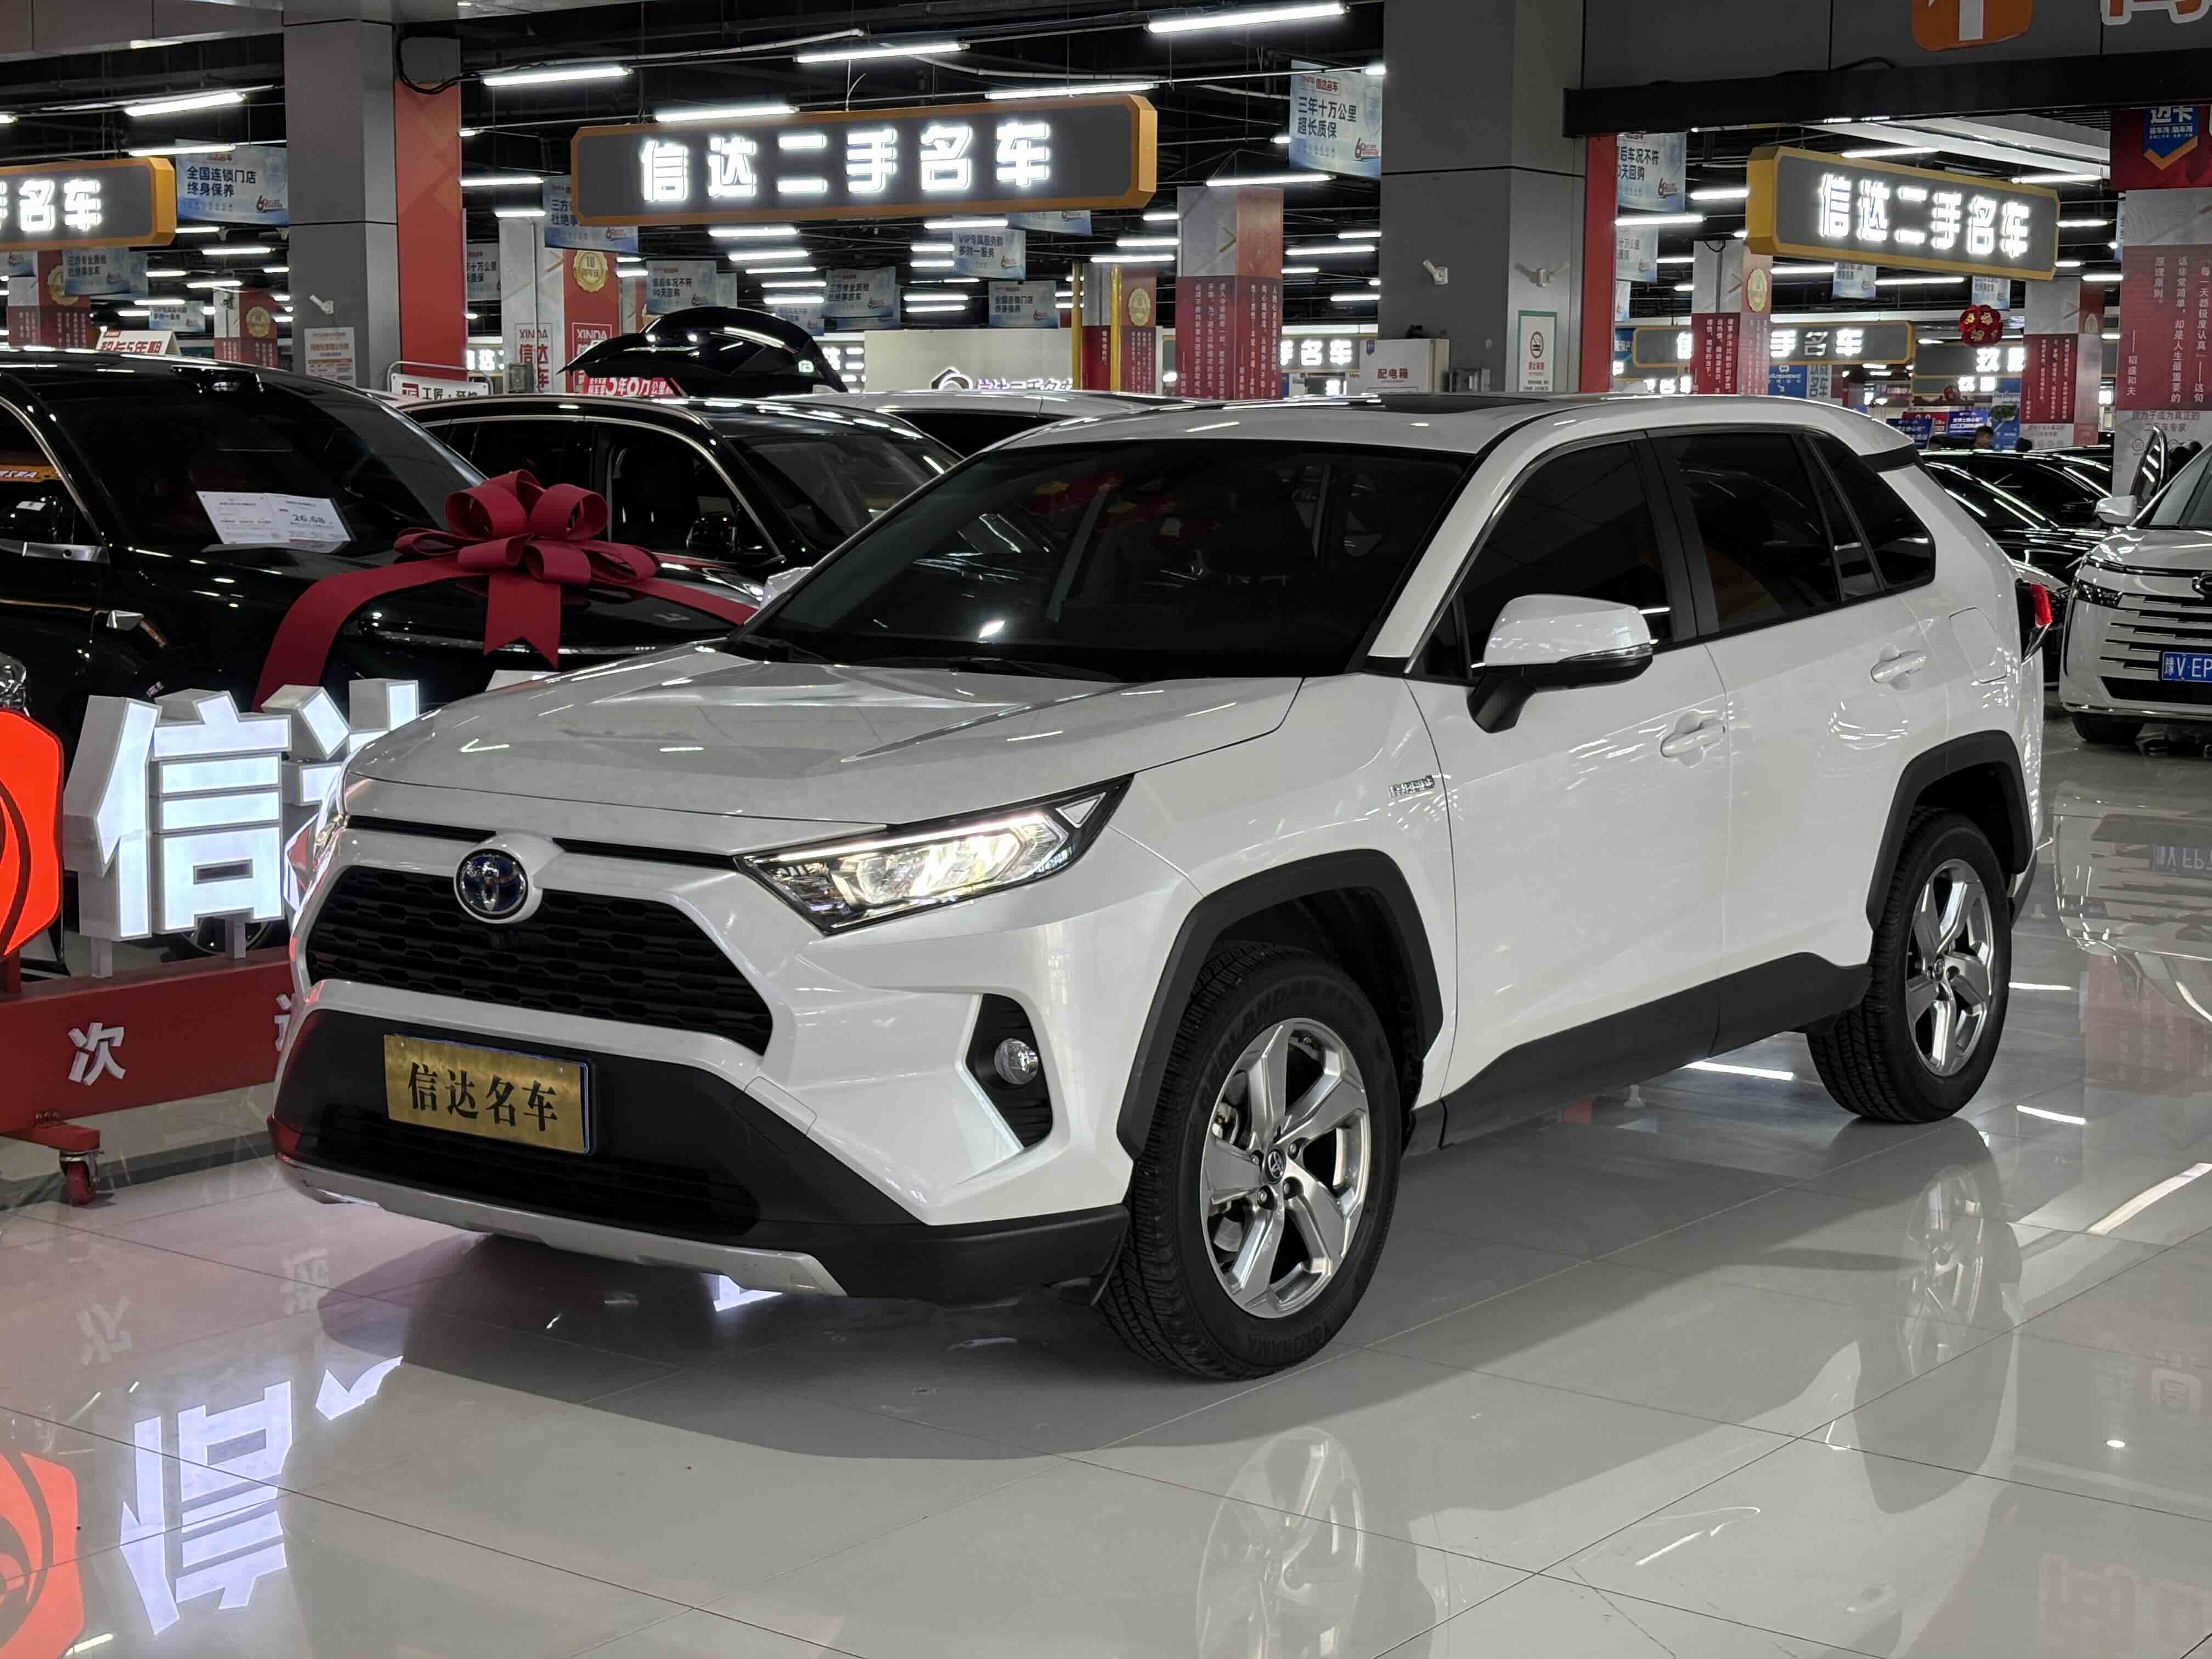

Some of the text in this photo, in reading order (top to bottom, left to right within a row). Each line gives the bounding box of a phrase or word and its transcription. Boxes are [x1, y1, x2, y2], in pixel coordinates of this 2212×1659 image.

[1298, 96, 1357, 122] 三年十万公里
[1297, 117, 1338, 138] 超长质保
[641, 122, 1050, 203] 信达二手名车
[187, 165, 257, 184] 全国连锁门店
[187, 182, 234, 198] 终身保养
[0, 179, 103, 232] 名车
[551, 199, 572, 212] 三方
[1819, 174, 2030, 258] 信达二手名车
[577, 329, 607, 340] XINDA
[1378, 368, 1408, 379] 配电箱
[408, 1061, 558, 1131] 信达名车
